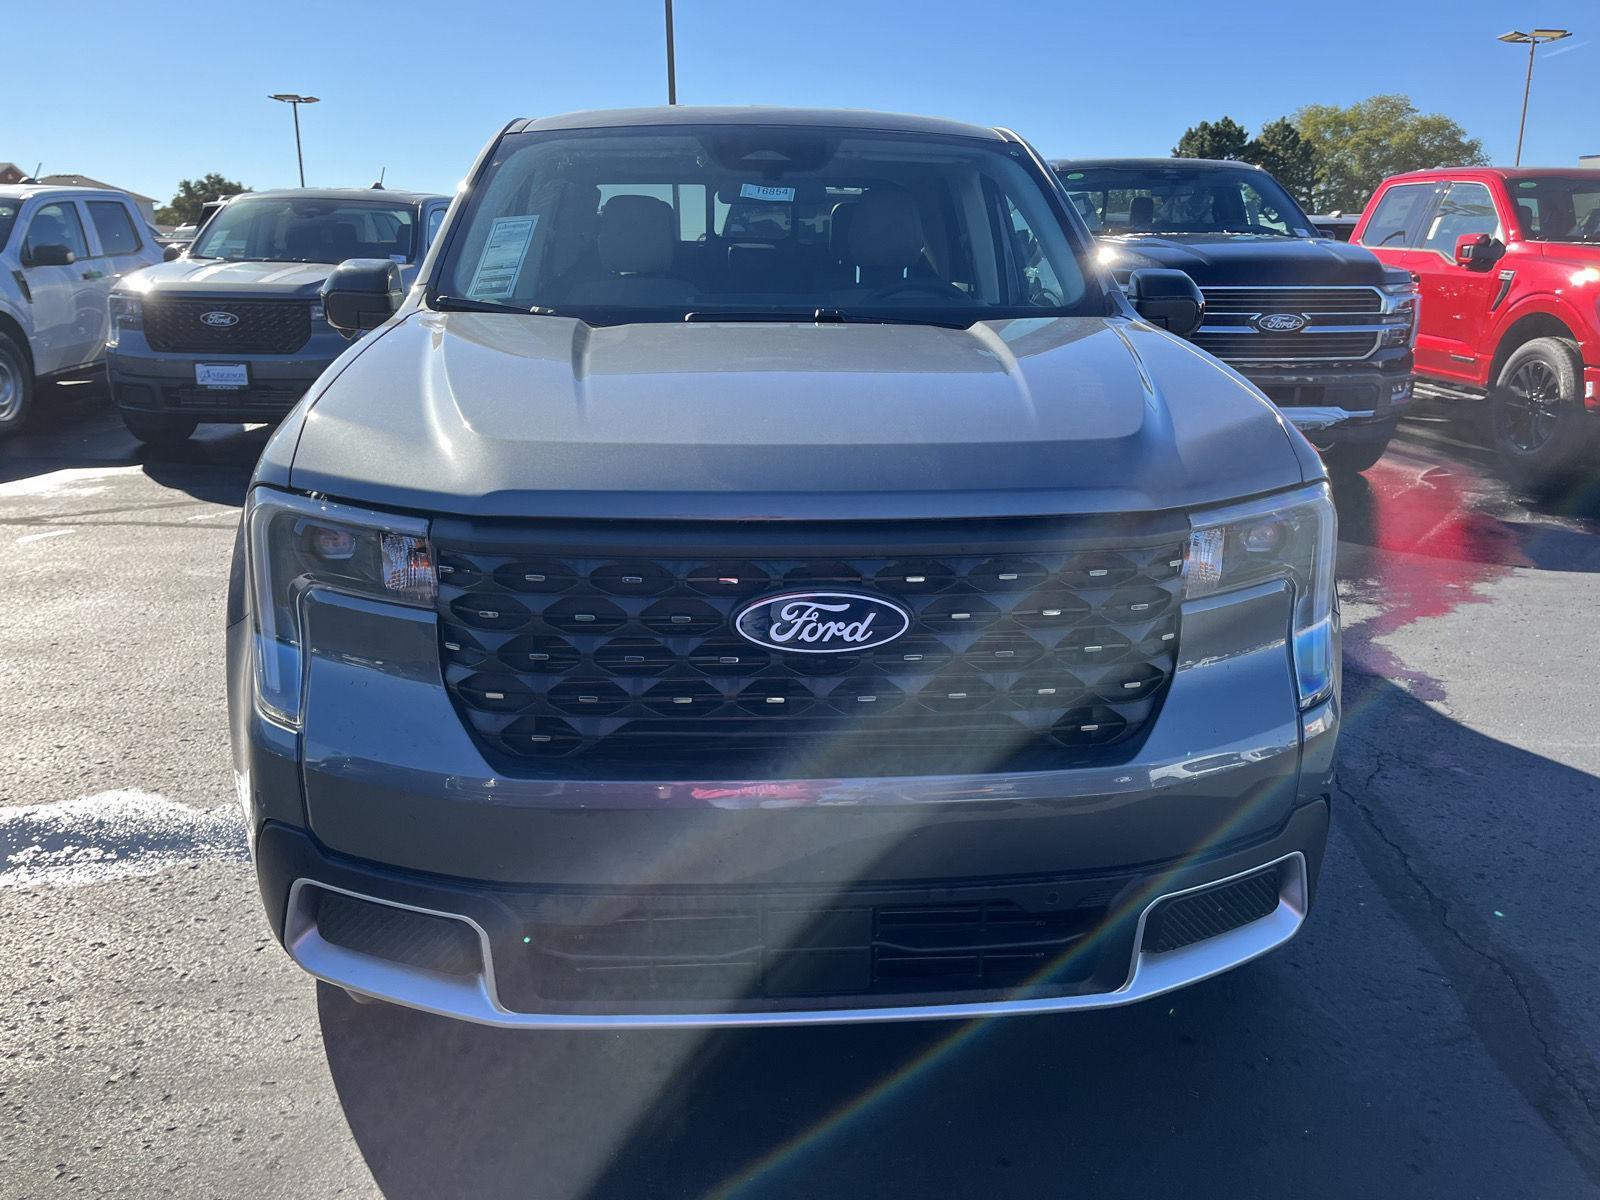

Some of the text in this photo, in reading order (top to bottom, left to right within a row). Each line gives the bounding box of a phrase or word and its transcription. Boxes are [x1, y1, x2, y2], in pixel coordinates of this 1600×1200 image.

[755, 186, 789, 196] 16854
[1267, 316, 1296, 329] Ford
[769, 601, 877, 643] Ford
